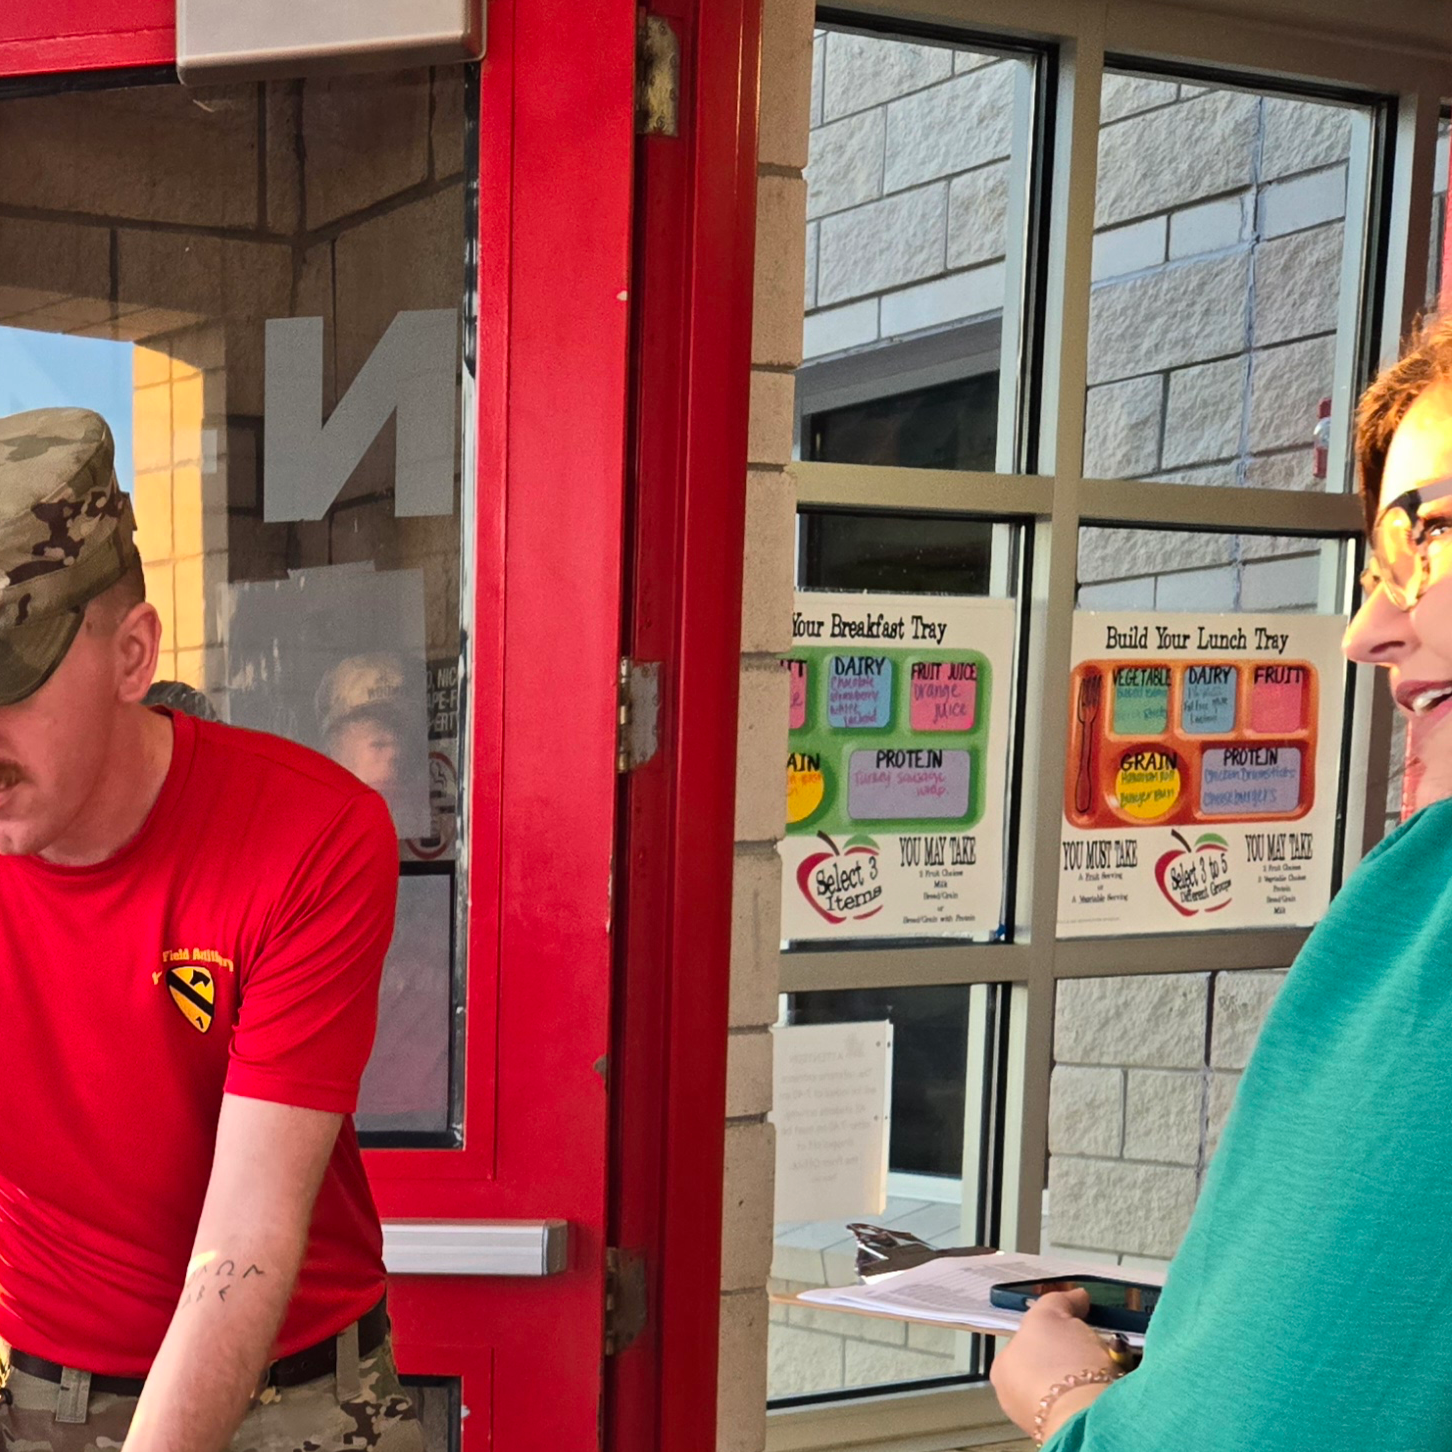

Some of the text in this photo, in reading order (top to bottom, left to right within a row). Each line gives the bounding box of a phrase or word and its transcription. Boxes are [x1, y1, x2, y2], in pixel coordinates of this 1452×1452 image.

[792, 612, 947, 645] Your Breakfast Tray
[1105, 625, 1289, 655] Build Your Lunch Tray
[834, 656, 886, 676] DAIRY
[911, 662, 977, 681] FRUIT JUICE
[1188, 665, 1233, 685] DAIRY
[1254, 665, 1304, 685] FRUIT
[1112, 667, 1172, 687] VEGETABLE
[875, 749, 943, 769] PROTEIN
[1120, 752, 1177, 771] GRAIN
[1223, 748, 1278, 766] PROTEIN
[899, 835, 977, 867] YOU MAY TAKE
[1062, 839, 1138, 871] YOU MUST TAKE
[1245, 832, 1314, 862] YOU MAY TAKE
[816, 855, 878, 896] Select 3
[1170, 852, 1228, 891] Select 3 to 5
[825, 885, 883, 911] Items
[1180, 886, 1210, 903] Different
[163, 948, 190, 962] Field
